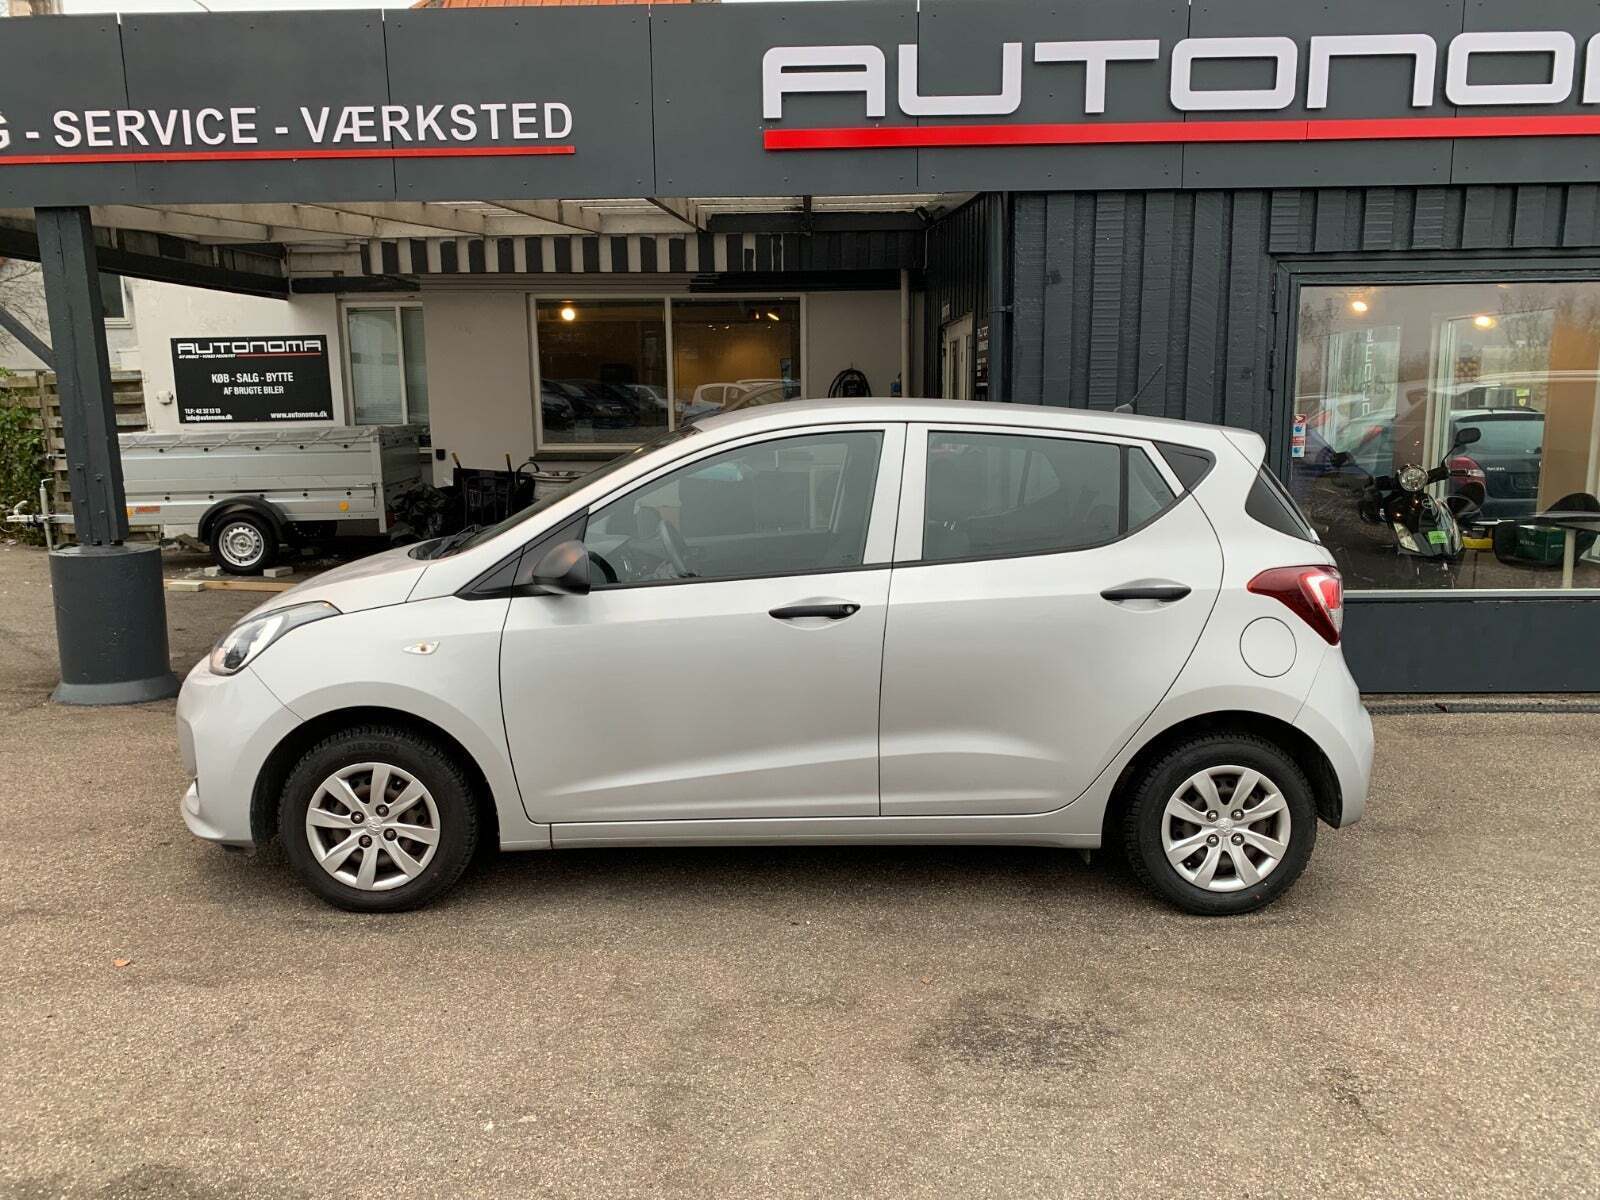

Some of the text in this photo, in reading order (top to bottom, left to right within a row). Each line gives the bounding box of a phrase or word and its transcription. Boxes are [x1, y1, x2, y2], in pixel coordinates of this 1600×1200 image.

[762, 31, 1600, 119] AUTONO
[53, 107, 258, 148] SERVICE
[300, 102, 573, 143] VÆRKSTED
[177, 340, 322, 354] AUTONOMA
[211, 373, 229, 384] KØB
[236, 372, 259, 383] SALG
[265, 371, 294, 383] BYTTE
[223, 385, 284, 396] AF BRUGTE BILER
